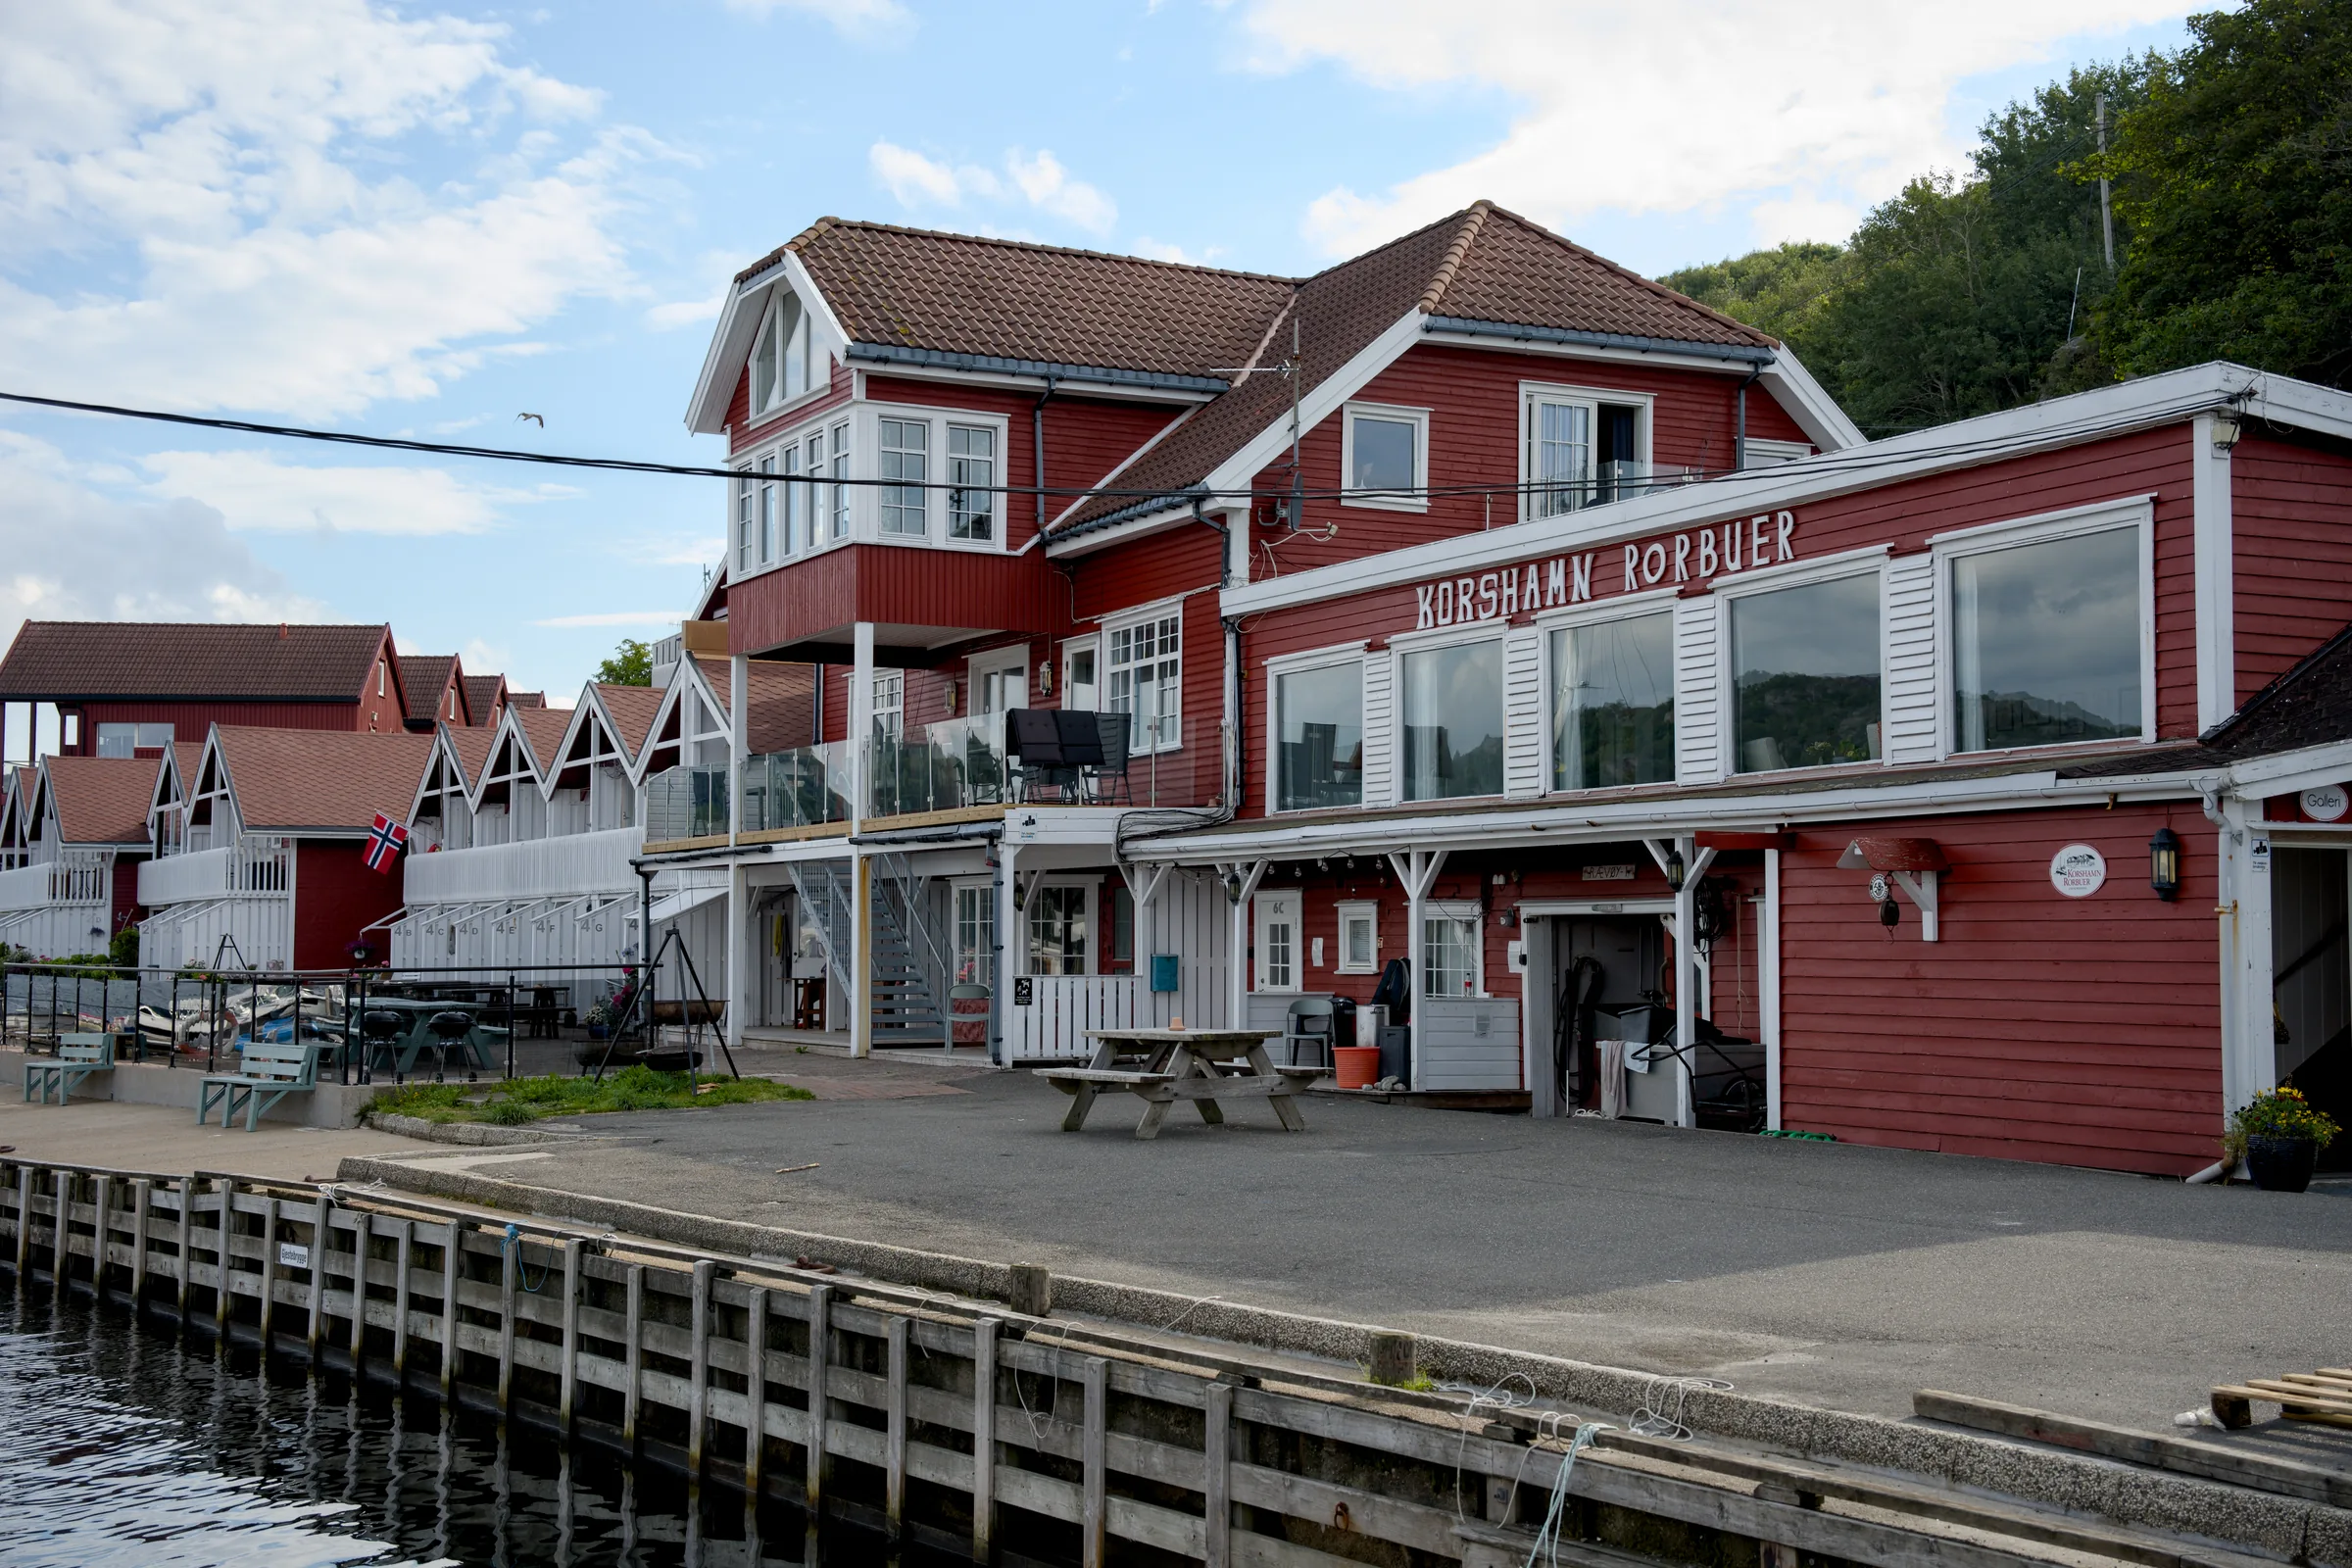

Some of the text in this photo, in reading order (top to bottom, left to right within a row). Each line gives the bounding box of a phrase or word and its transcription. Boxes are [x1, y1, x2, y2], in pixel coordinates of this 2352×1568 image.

[1416, 511, 1795, 630] KORSHAMN RORBUER
[2307, 794, 2341, 808] Galleri
[2067, 869, 2102, 878] KORSHAMN
[2063, 877, 2090, 887] RORBUER
[1273, 902, 1285, 914] 6C
